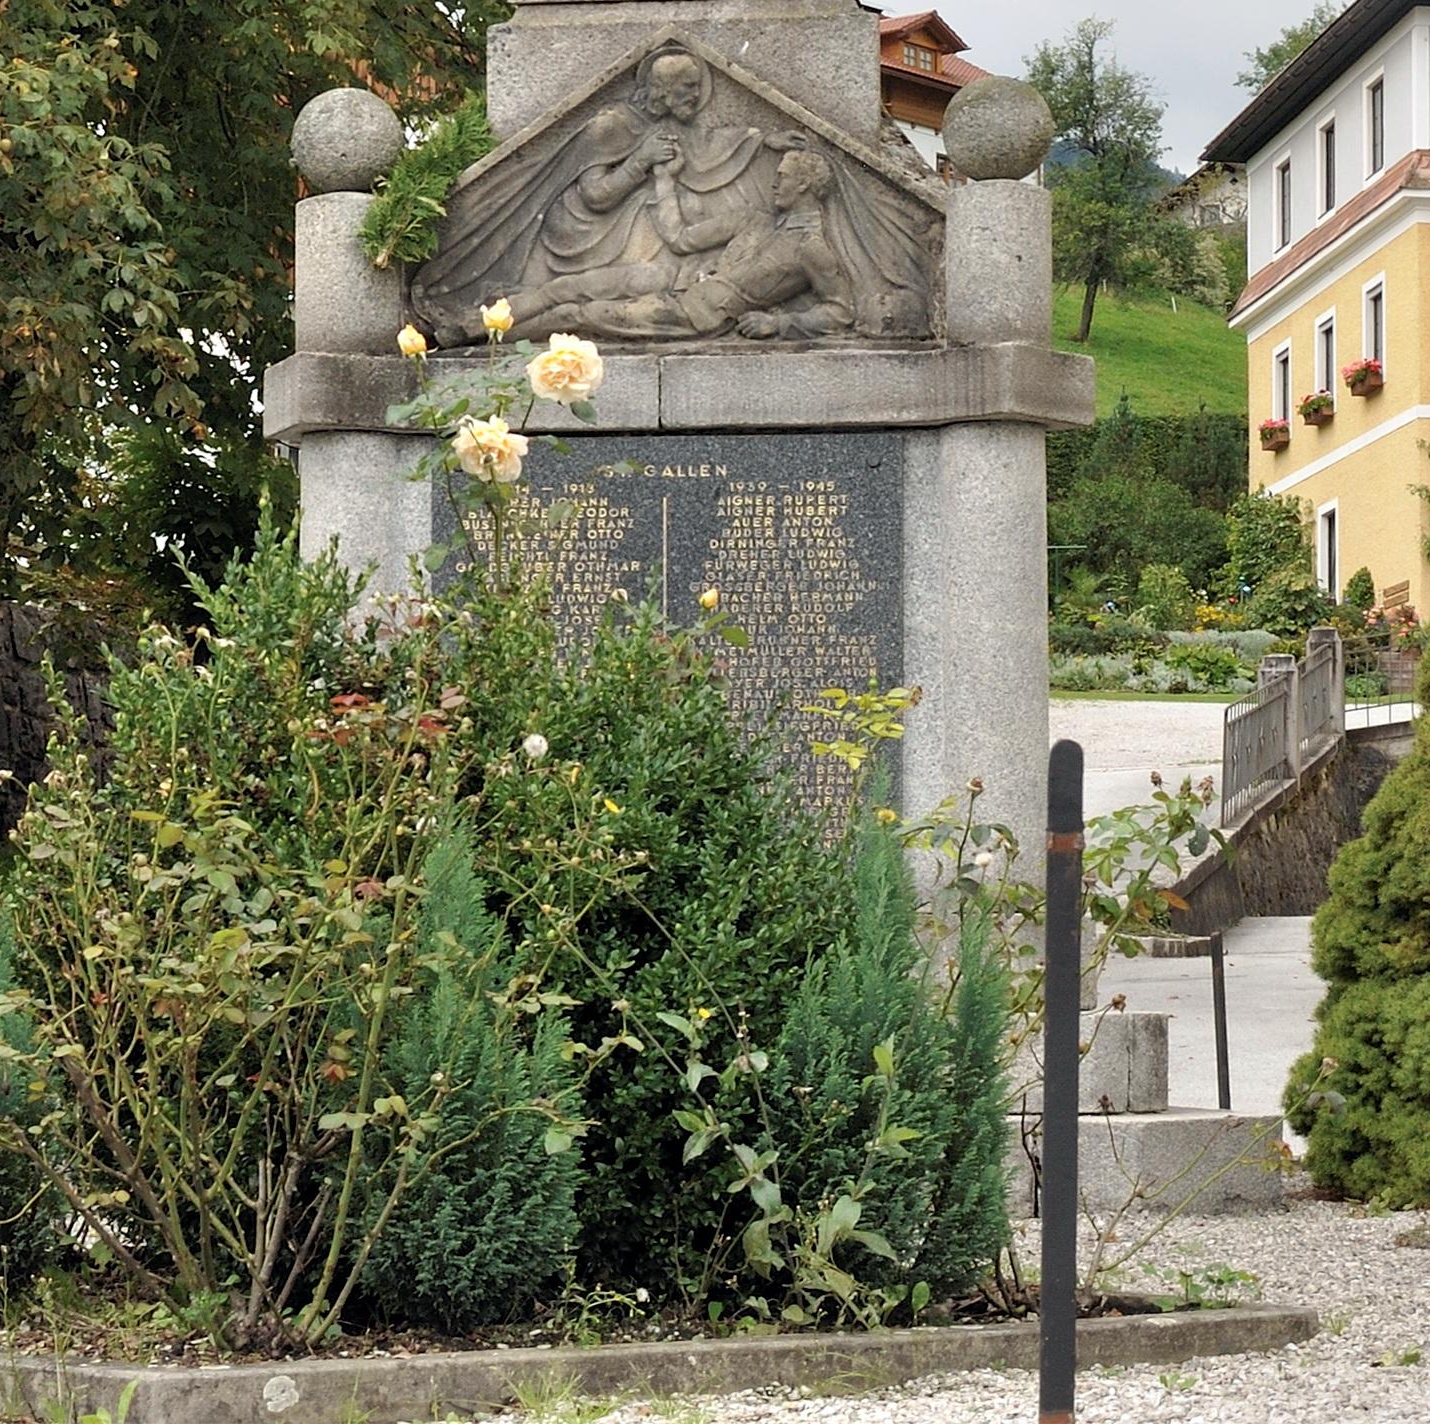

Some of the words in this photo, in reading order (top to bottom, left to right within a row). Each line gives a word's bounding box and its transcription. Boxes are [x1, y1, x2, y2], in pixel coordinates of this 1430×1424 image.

[644, 464, 727, 478] GALLEN
[799, 480, 835, 492] 1945
[717, 495, 776, 507] AIGNER
[783, 494, 848, 506] RUPERT
[716, 505, 776, 517] AIGNER
[783, 505, 848, 517] HUBERT
[587, 518, 635, 529] FRANZ
[732, 516, 773, 528] AUER
[781, 516, 834, 527] ANTON
[586, 529, 625, 540] OTTO
[781, 526, 843, 538] LUDWIG
[709, 539, 798, 550] DIRNINGER
[806, 538, 856, 549] FRANZ
[559, 550, 609, 562] FRANZ
[787, 549, 846, 560] LUDWIG
[574, 560, 641, 573] OTHMAR
[800, 559, 860, 571] LUDWIG
[774, 570, 860, 581] FRIEDRICH
[547, 594, 608, 605] LUDWIG
[789, 592, 864, 603] HERMANN
[737, 614, 779, 625] HELM
[787, 613, 827, 625] OTTO
[828, 634, 878, 645] FRANZ
